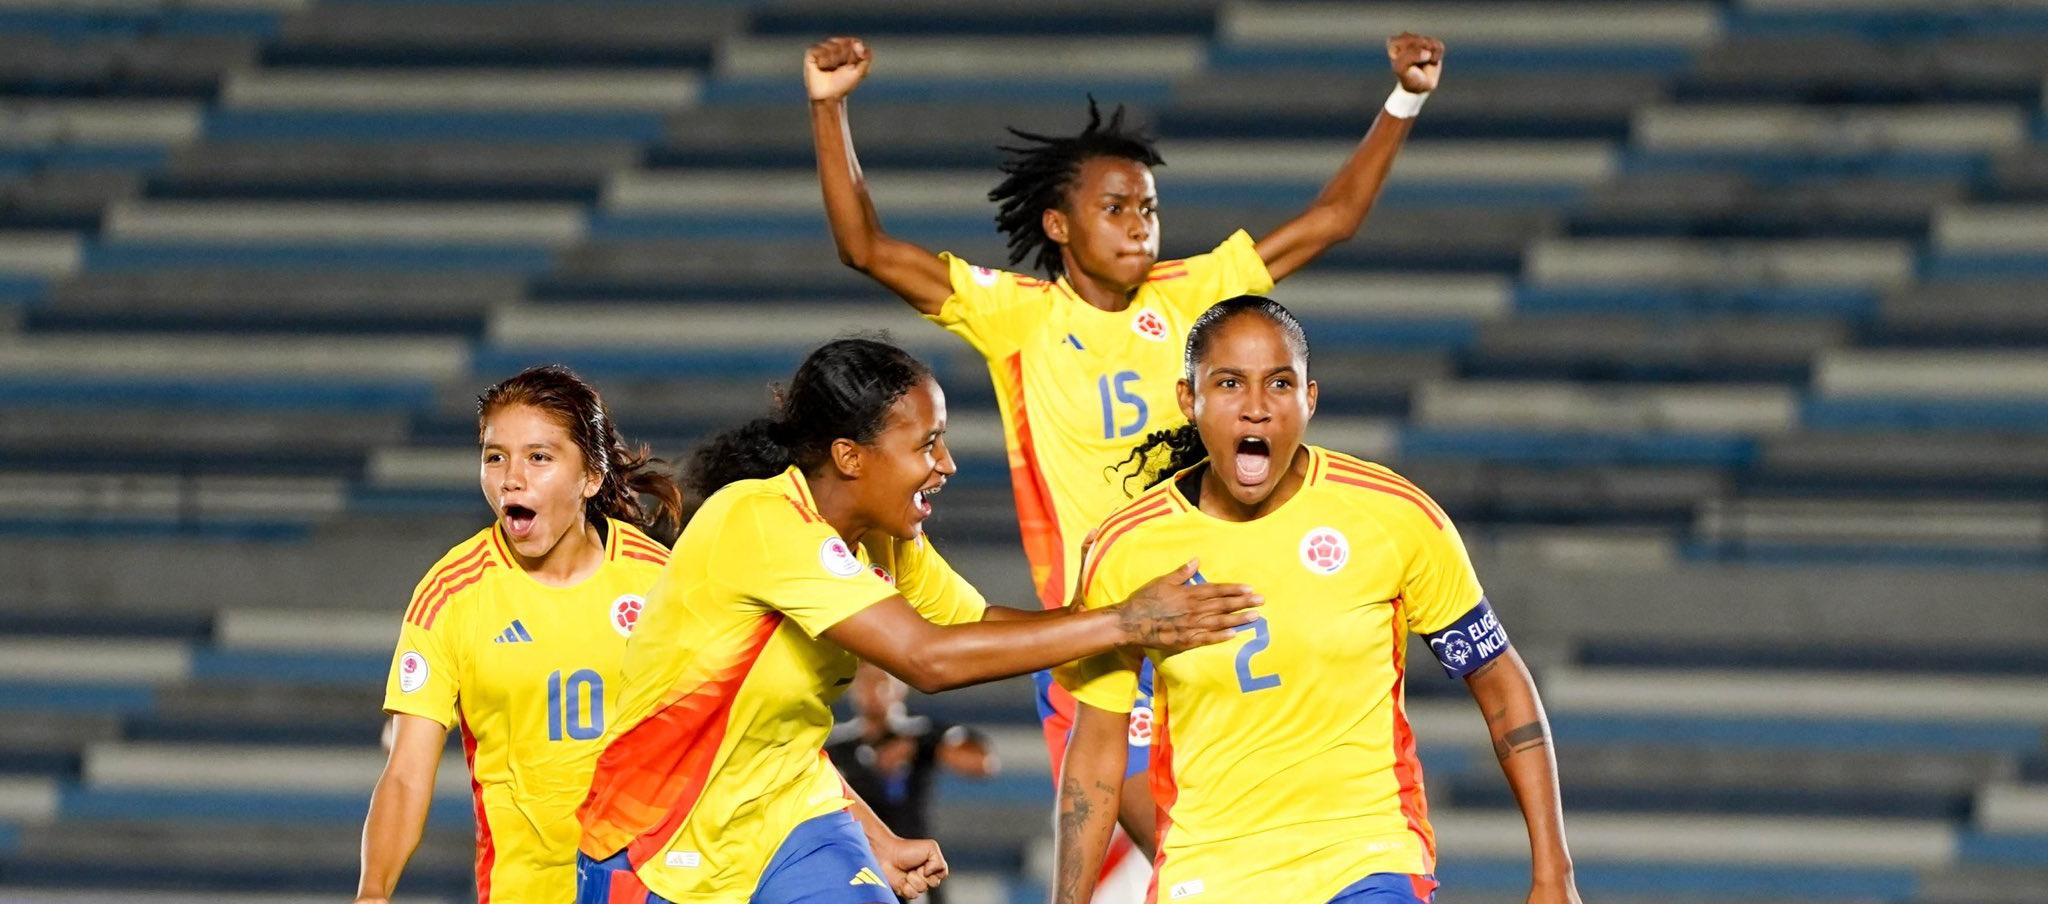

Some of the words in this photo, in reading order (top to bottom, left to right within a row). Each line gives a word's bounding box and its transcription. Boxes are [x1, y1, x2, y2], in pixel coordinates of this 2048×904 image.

[1098, 371, 1148, 439] 15
[1233, 616, 1282, 693] 2
[1467, 610, 1498, 641] ELIGE
[547, 669, 604, 741] 10
